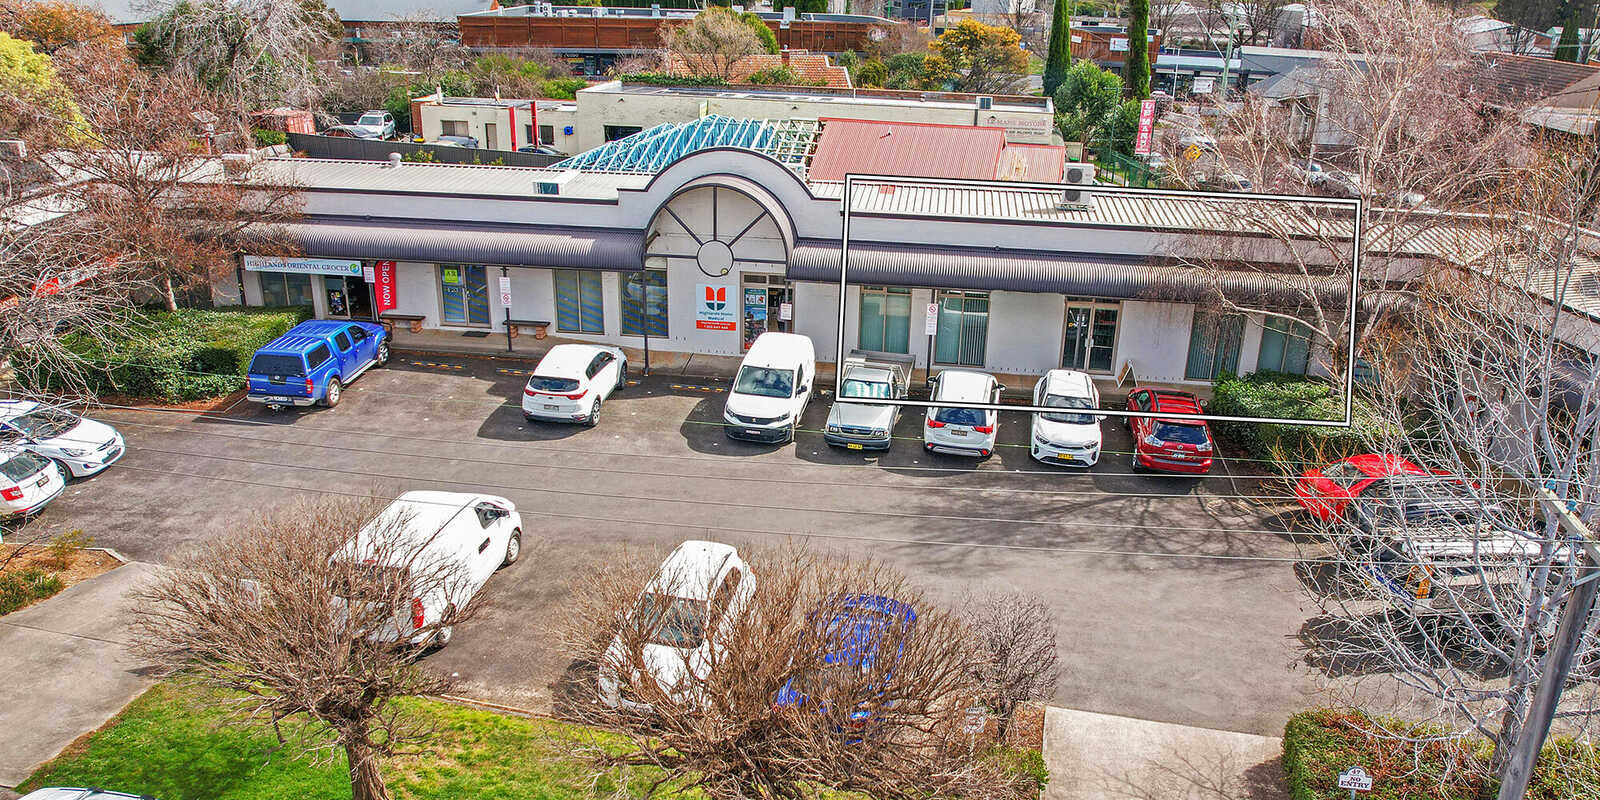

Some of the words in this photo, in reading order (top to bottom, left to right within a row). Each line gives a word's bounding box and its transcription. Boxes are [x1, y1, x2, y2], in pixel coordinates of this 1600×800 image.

[247, 260, 287, 269] HIGHLANDS
[287, 262, 321, 270] ORIENTAL
[322, 264, 350, 272] GROCER
[382, 260, 390, 283] OPEN
[383, 285, 391, 306] NOW
[1340, 780, 1369, 789] ENTRY
